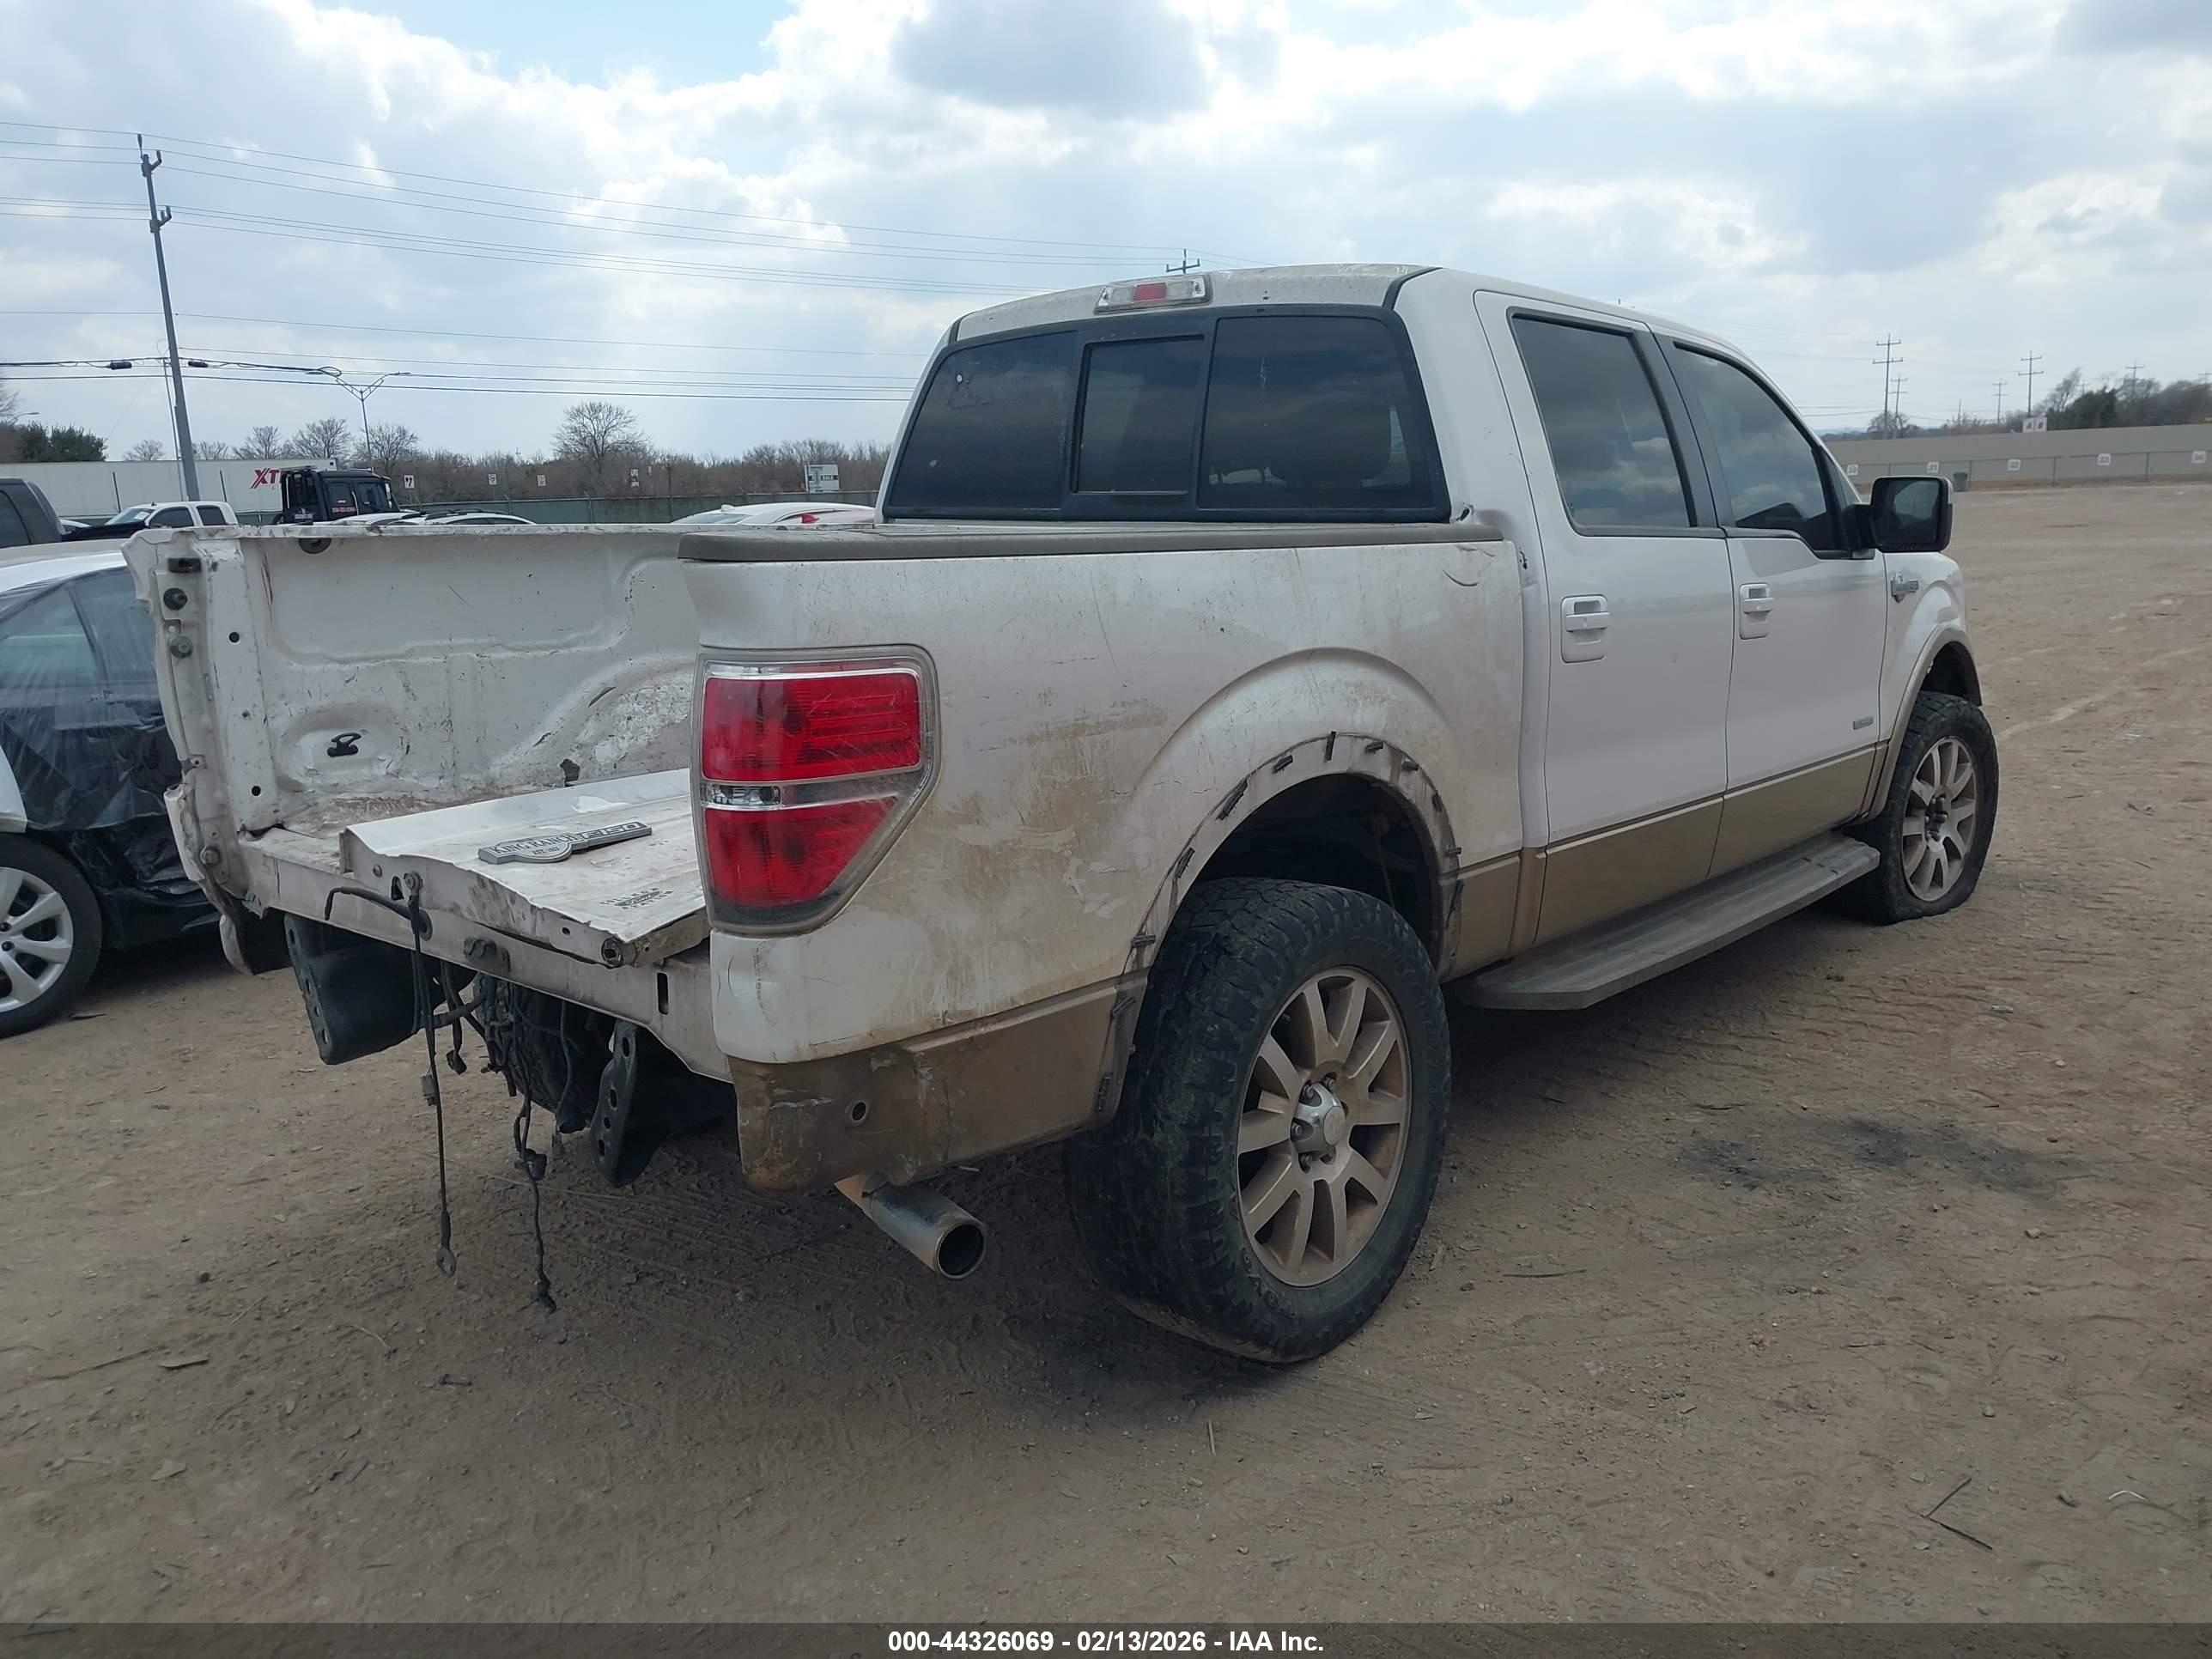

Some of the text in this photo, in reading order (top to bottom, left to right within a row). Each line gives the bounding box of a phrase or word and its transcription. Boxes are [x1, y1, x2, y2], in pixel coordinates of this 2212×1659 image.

[250, 467, 281, 489] XT
[489, 823, 641, 854] KING RANCH F-150
